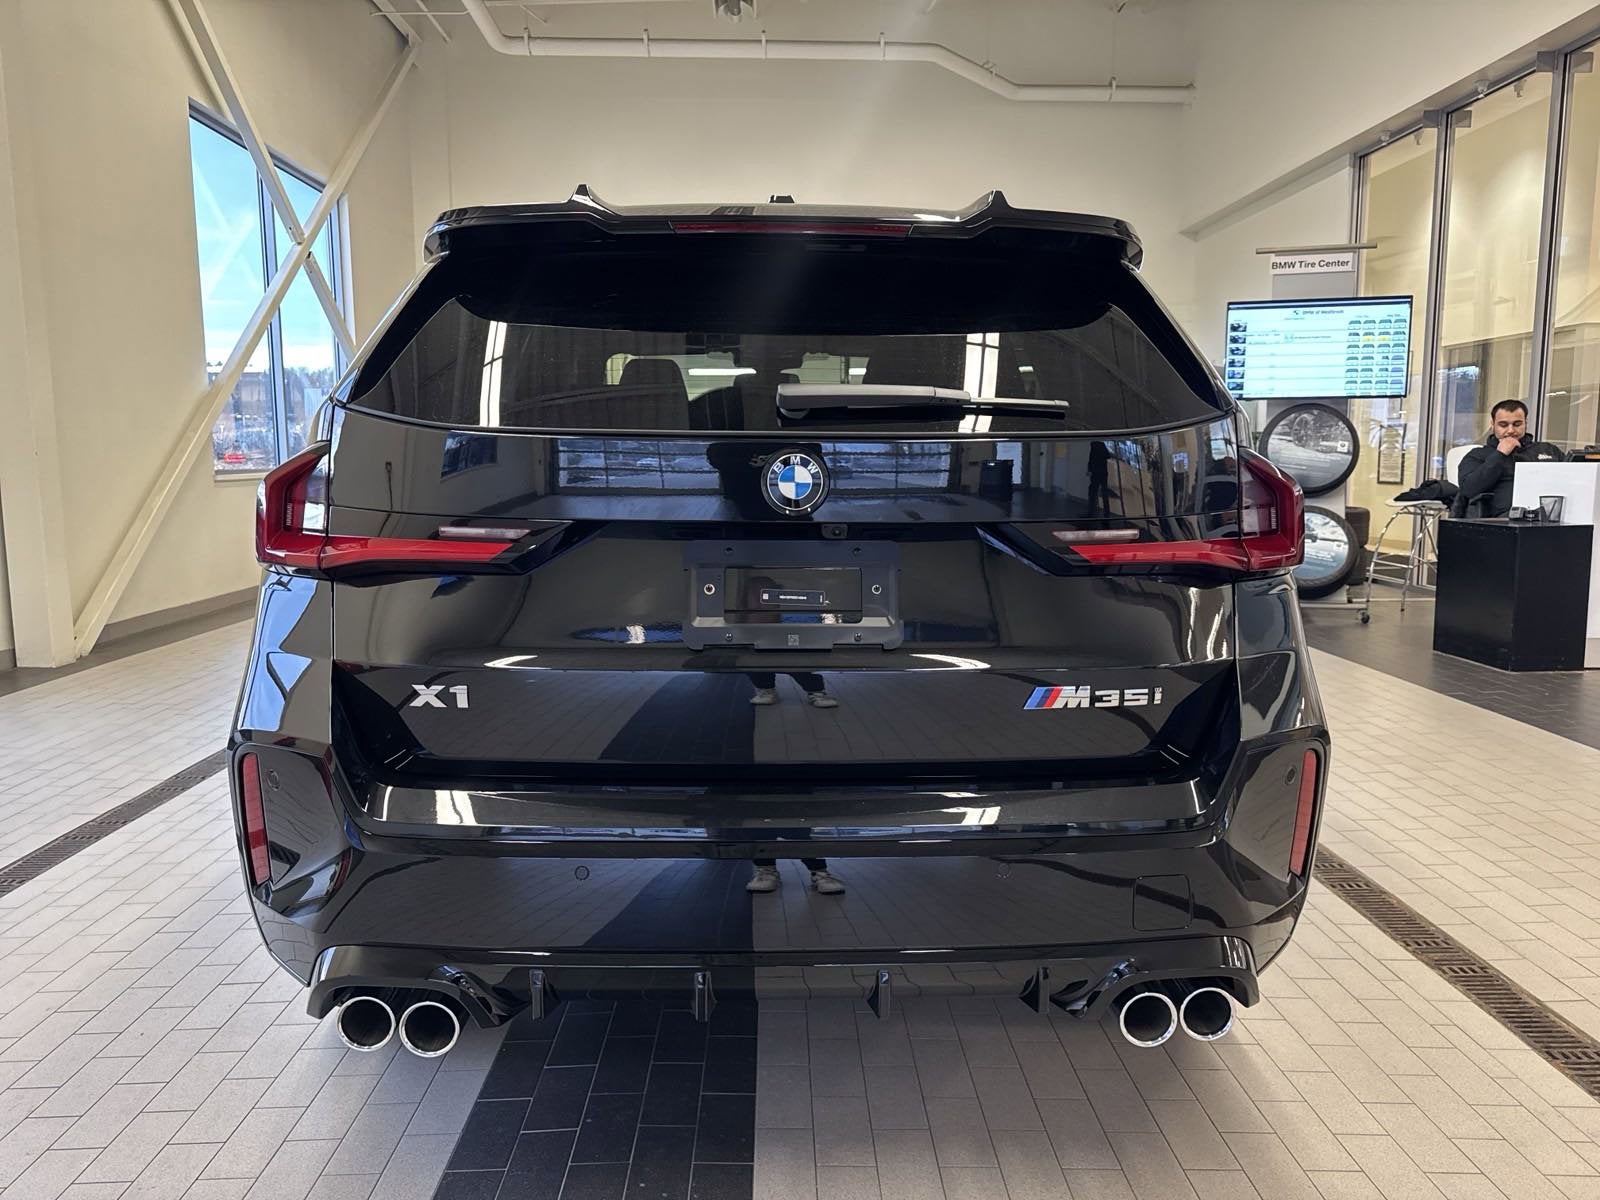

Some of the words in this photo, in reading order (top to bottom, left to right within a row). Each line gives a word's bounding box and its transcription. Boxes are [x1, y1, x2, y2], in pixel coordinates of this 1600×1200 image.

[1271, 261, 1297, 270] BMW
[1297, 260, 1316, 269] Tire
[1318, 259, 1350, 268] Center
[772, 455, 819, 474] BMW
[408, 684, 469, 709] X1
